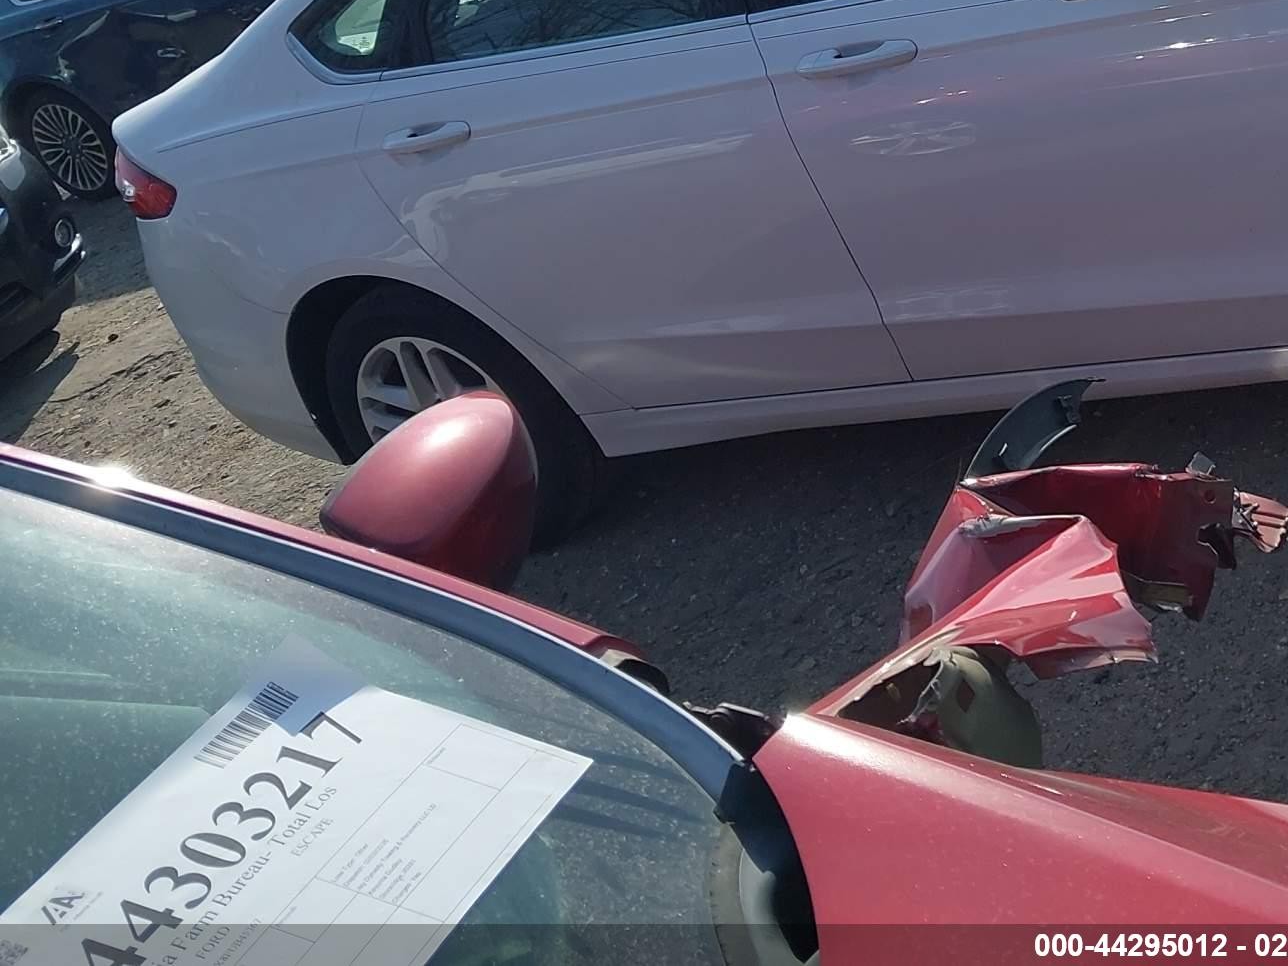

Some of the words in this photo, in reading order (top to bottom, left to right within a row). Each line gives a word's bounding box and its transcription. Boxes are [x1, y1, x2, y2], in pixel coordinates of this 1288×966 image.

[81, 711, 363, 966] 44303217
[169, 909, 218, 951] Farm
[268, 811, 311, 847] Total
[305, 786, 337, 811] Los
[194, 925, 230, 960] FORD
[290, 818, 334, 857] ESCAPE
